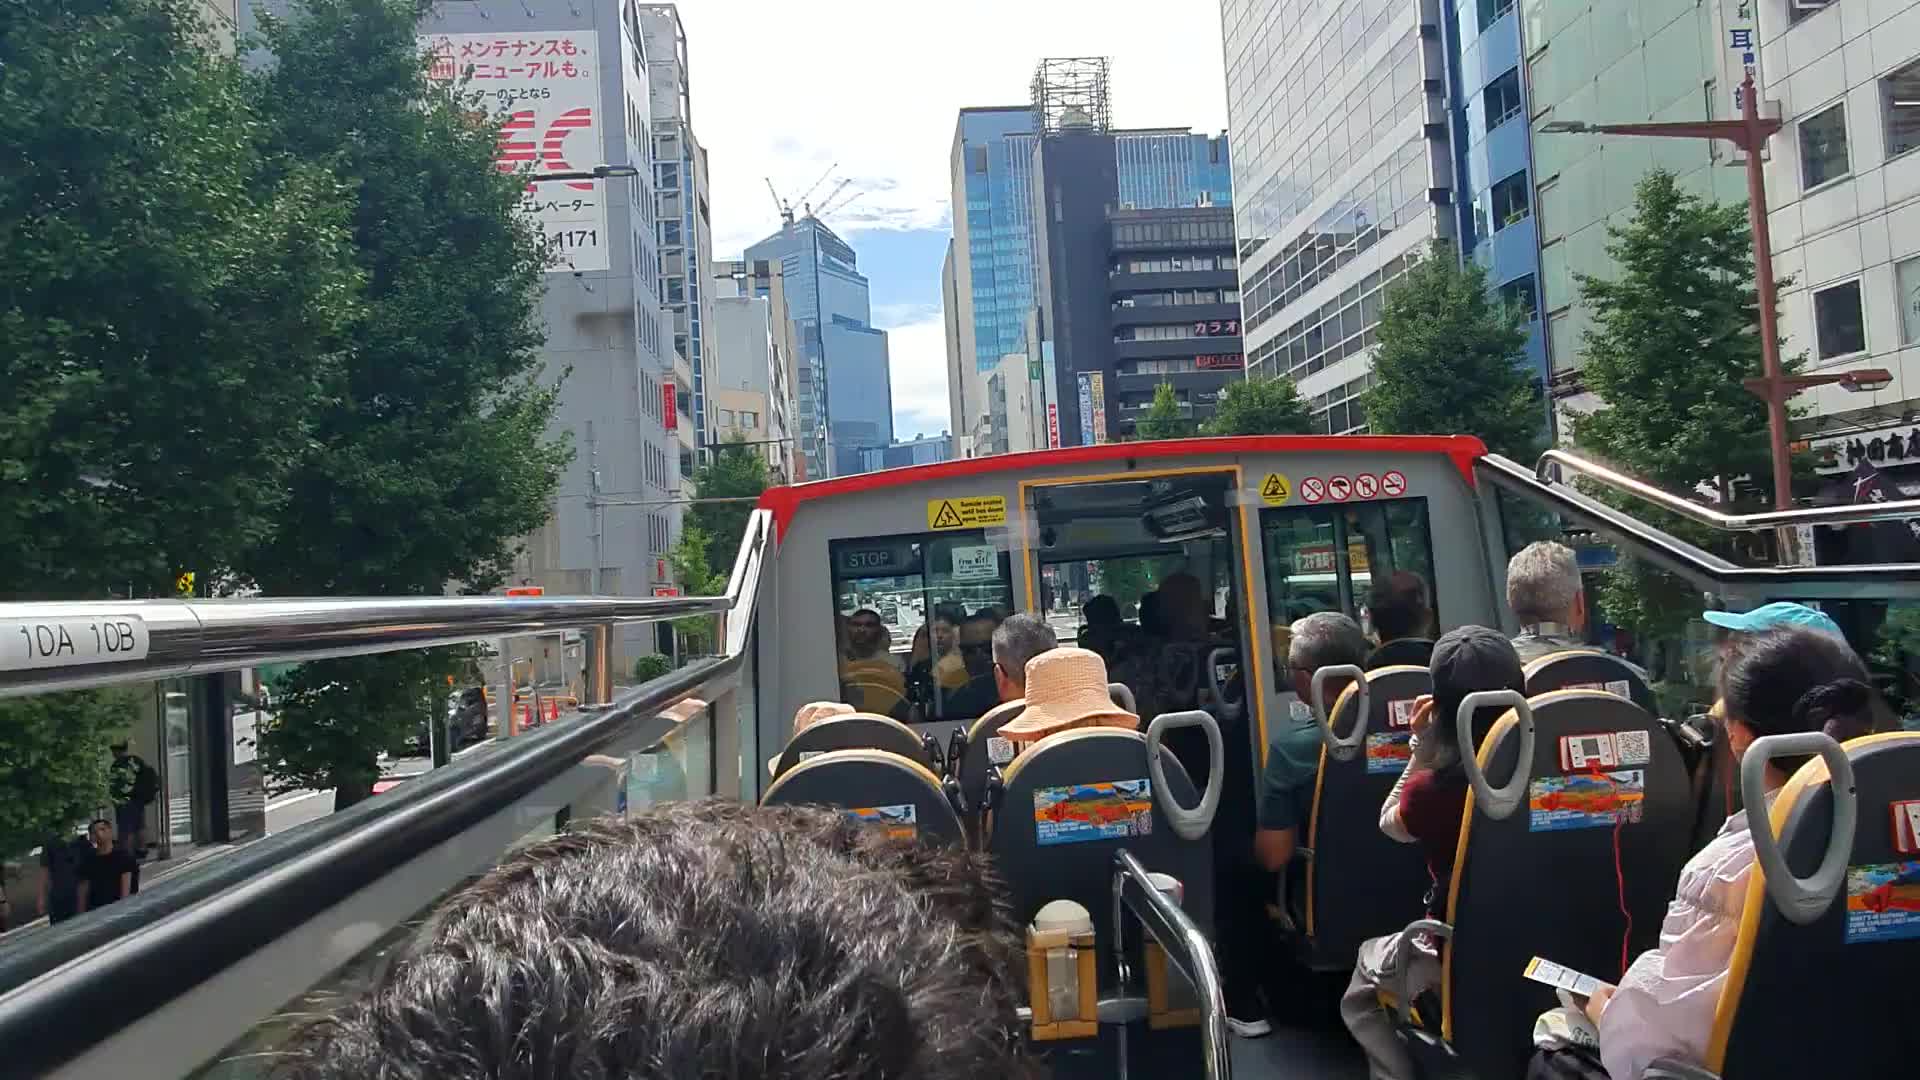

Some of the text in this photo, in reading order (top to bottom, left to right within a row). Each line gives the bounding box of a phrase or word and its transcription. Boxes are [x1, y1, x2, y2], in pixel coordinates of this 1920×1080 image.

[461, 39, 587, 57] メンテナンスも、
[849, 552, 889, 567] STOP
[20, 621, 135, 660] 10A 10B
